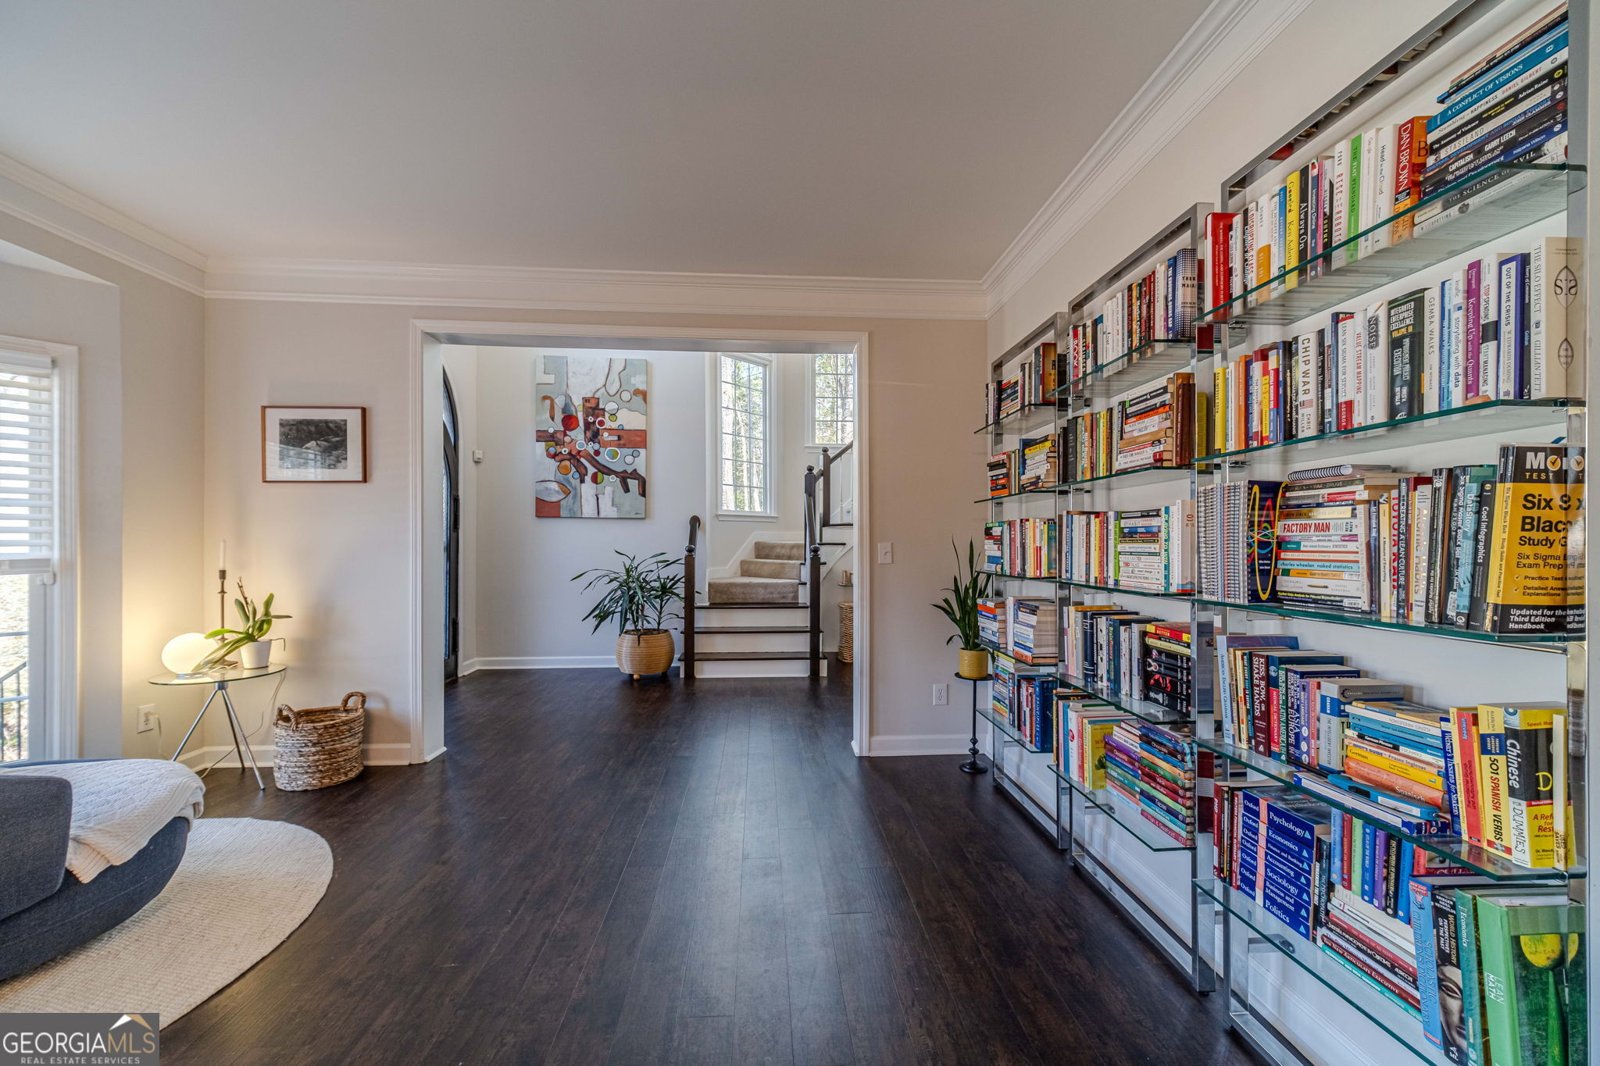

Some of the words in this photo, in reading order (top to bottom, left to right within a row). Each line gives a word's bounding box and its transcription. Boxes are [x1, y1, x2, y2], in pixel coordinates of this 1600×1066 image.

[1452, 90, 1485, 113] CONFLICT
[1495, 64, 1523, 86] VISIONS
[1400, 123, 1411, 150] DAN
[1399, 149, 1410, 192] BROWN
[1449, 154, 1473, 172] CAPITALISM
[1462, 173, 1499, 196] SCIENCE
[1299, 202, 1308, 235] Always
[1299, 235, 1307, 250] On
[1428, 296, 1436, 326] GEMBA
[1468, 297, 1476, 327] Keeping
[1534, 284, 1542, 313] EFFECT
[1368, 316, 1377, 349] NOISE
[1428, 329, 1436, 356] WALKS
[1453, 317, 1461, 354] storytelling
[1301, 338, 1310, 366] CHIP
[1301, 369, 1310, 396] WAR
[1454, 372, 1462, 388] data
[1467, 359, 1476, 385] Quants
[1463, 494, 1475, 532] DataStory
[1522, 493, 1553, 511] Six
[1283, 522, 1312, 533] FACTORY
[1313, 522, 1331, 533] MAN
[1416, 507, 1428, 553] Atomic
[1521, 516, 1567, 532] Blac
[1477, 524, 1488, 563] Infographics
[1518, 536, 1555, 550] Study
[1534, 553, 1561, 562] Sigma
[1414, 555, 1426, 595] Habits
[1516, 561, 1541, 569] Exam
[1542, 562, 1564, 571] Prep
[1510, 608, 1542, 617] Updated
[1543, 608, 1555, 616] for
[1252, 657, 1260, 686] SHAKE
[1253, 686, 1261, 716] HANDS
[1489, 757, 1499, 776] 501
[1506, 739, 1520, 789] Chinese
[1490, 775, 1501, 813] SPANISH
[1244, 800, 1259, 812] Oxford
[1269, 812, 1305, 836] Psychology
[1492, 814, 1503, 842] VERBS
[1512, 806, 1526, 854] DUMMIES
[1243, 816, 1258, 828] Oxford
[1268, 829, 1299, 851] Economics
[1243, 828, 1258, 841] Oxford
[1242, 839, 1257, 852] Oxford
[1267, 855, 1294, 877] Accounting
[1241, 851, 1257, 866] Oxford
[1266, 868, 1299, 895] Sociology
[1265, 900, 1290, 923] Politics
[1424, 939, 1437, 1004] SCHOLASTIC
[1486, 973, 1495, 999] MATH
[1417, 966, 1430, 1026] DICTIONARY
